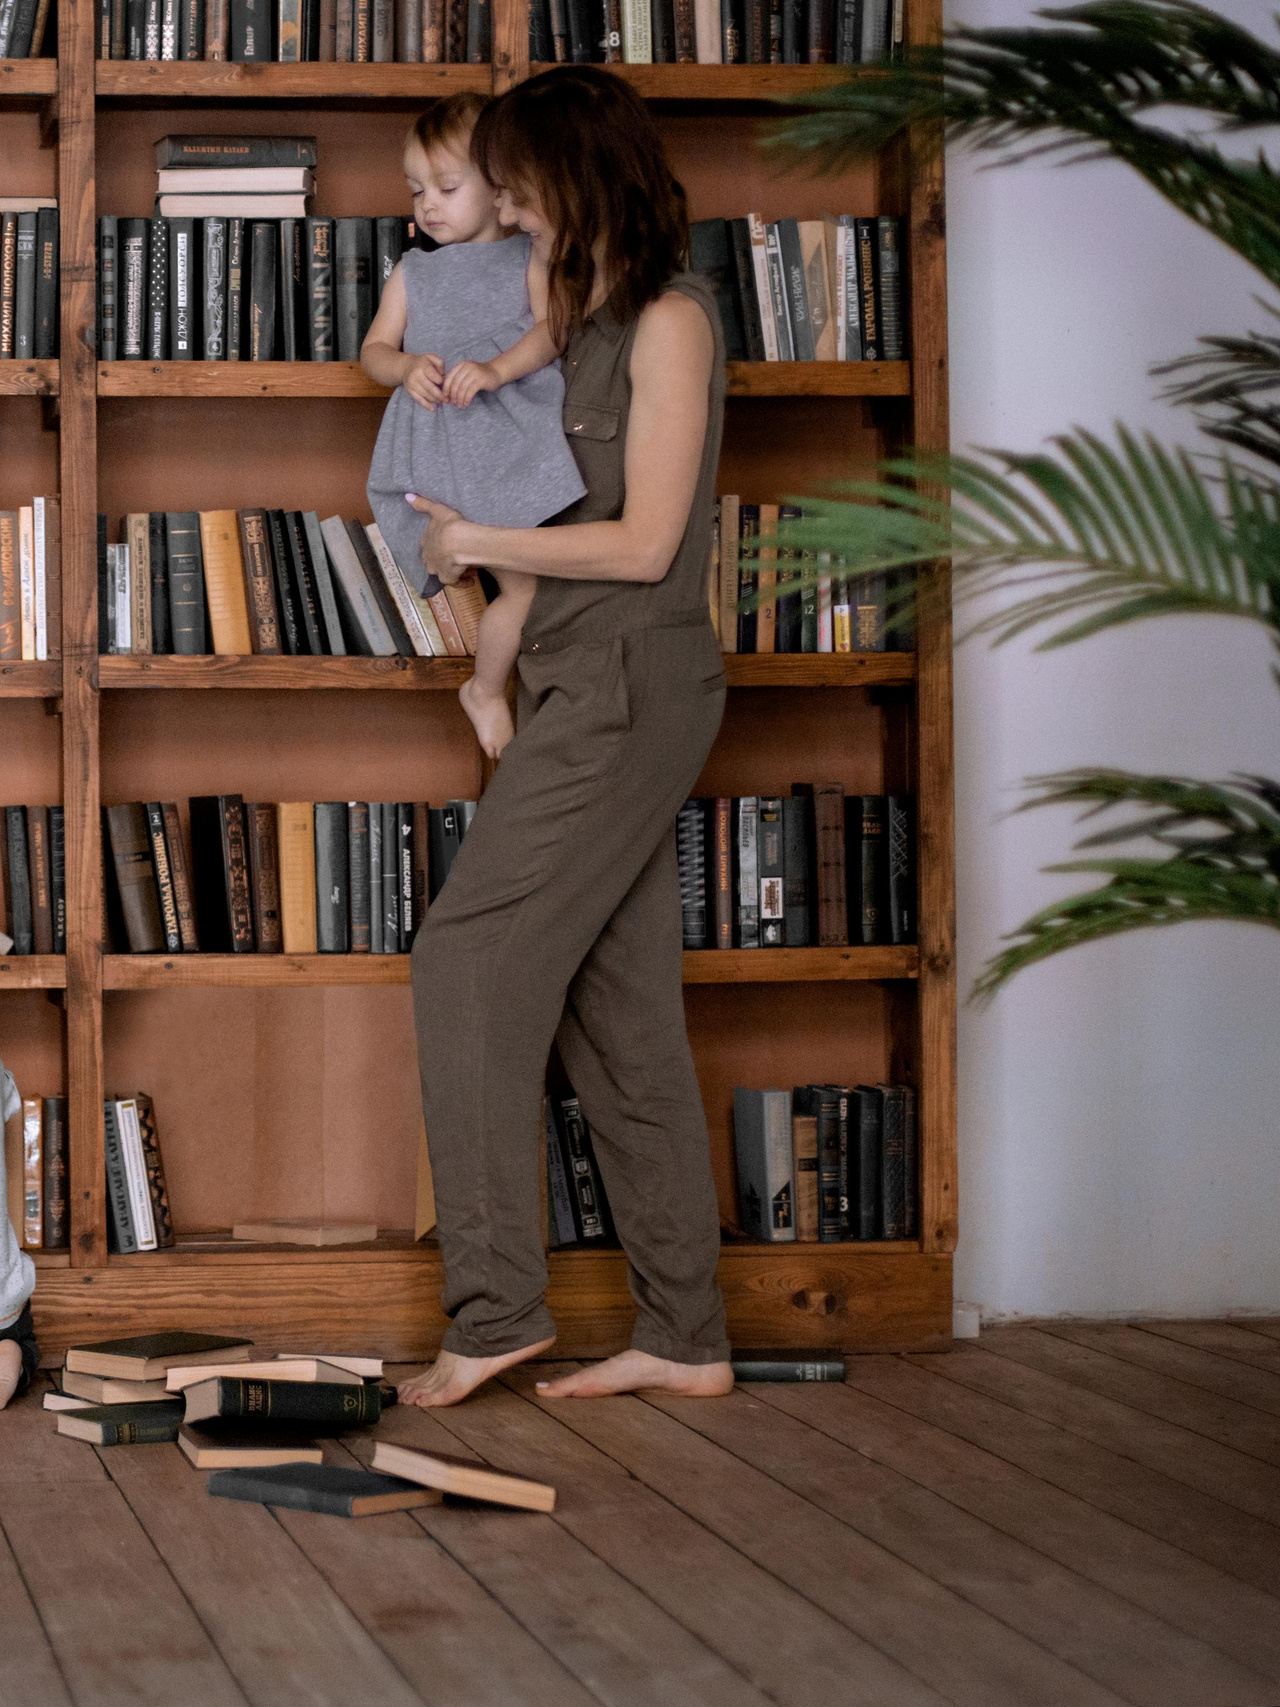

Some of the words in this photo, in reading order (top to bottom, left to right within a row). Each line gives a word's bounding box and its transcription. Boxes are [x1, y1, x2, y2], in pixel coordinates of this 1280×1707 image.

[357, 12, 368, 62] МИХАИЛ
[609, 31, 619, 47] 8
[2, 237, 14, 297] ШОЛОХОВ
[860, 240, 873, 291] РОББИНС
[1, 300, 11, 352] МИХАИЛ
[177, 308, 187, 340] ДЖОН
[862, 291, 875, 341] ГАРОЛЬД
[765, 608, 772, 618] 2
[401, 824, 411, 835] 4
[718, 810, 727, 852] ШОЛОХОВ
[153, 831, 170, 884] РОББИНС
[402, 848, 411, 899] АЛЕКСАНДР
[719, 855, 727, 891] МИХАИЛ
[162, 883, 177, 935] ГАРОЛЬД
[404, 900, 412, 932] БЕЛЯЕВ
[112, 1166, 129, 1231] АНАТОЛИЙ
